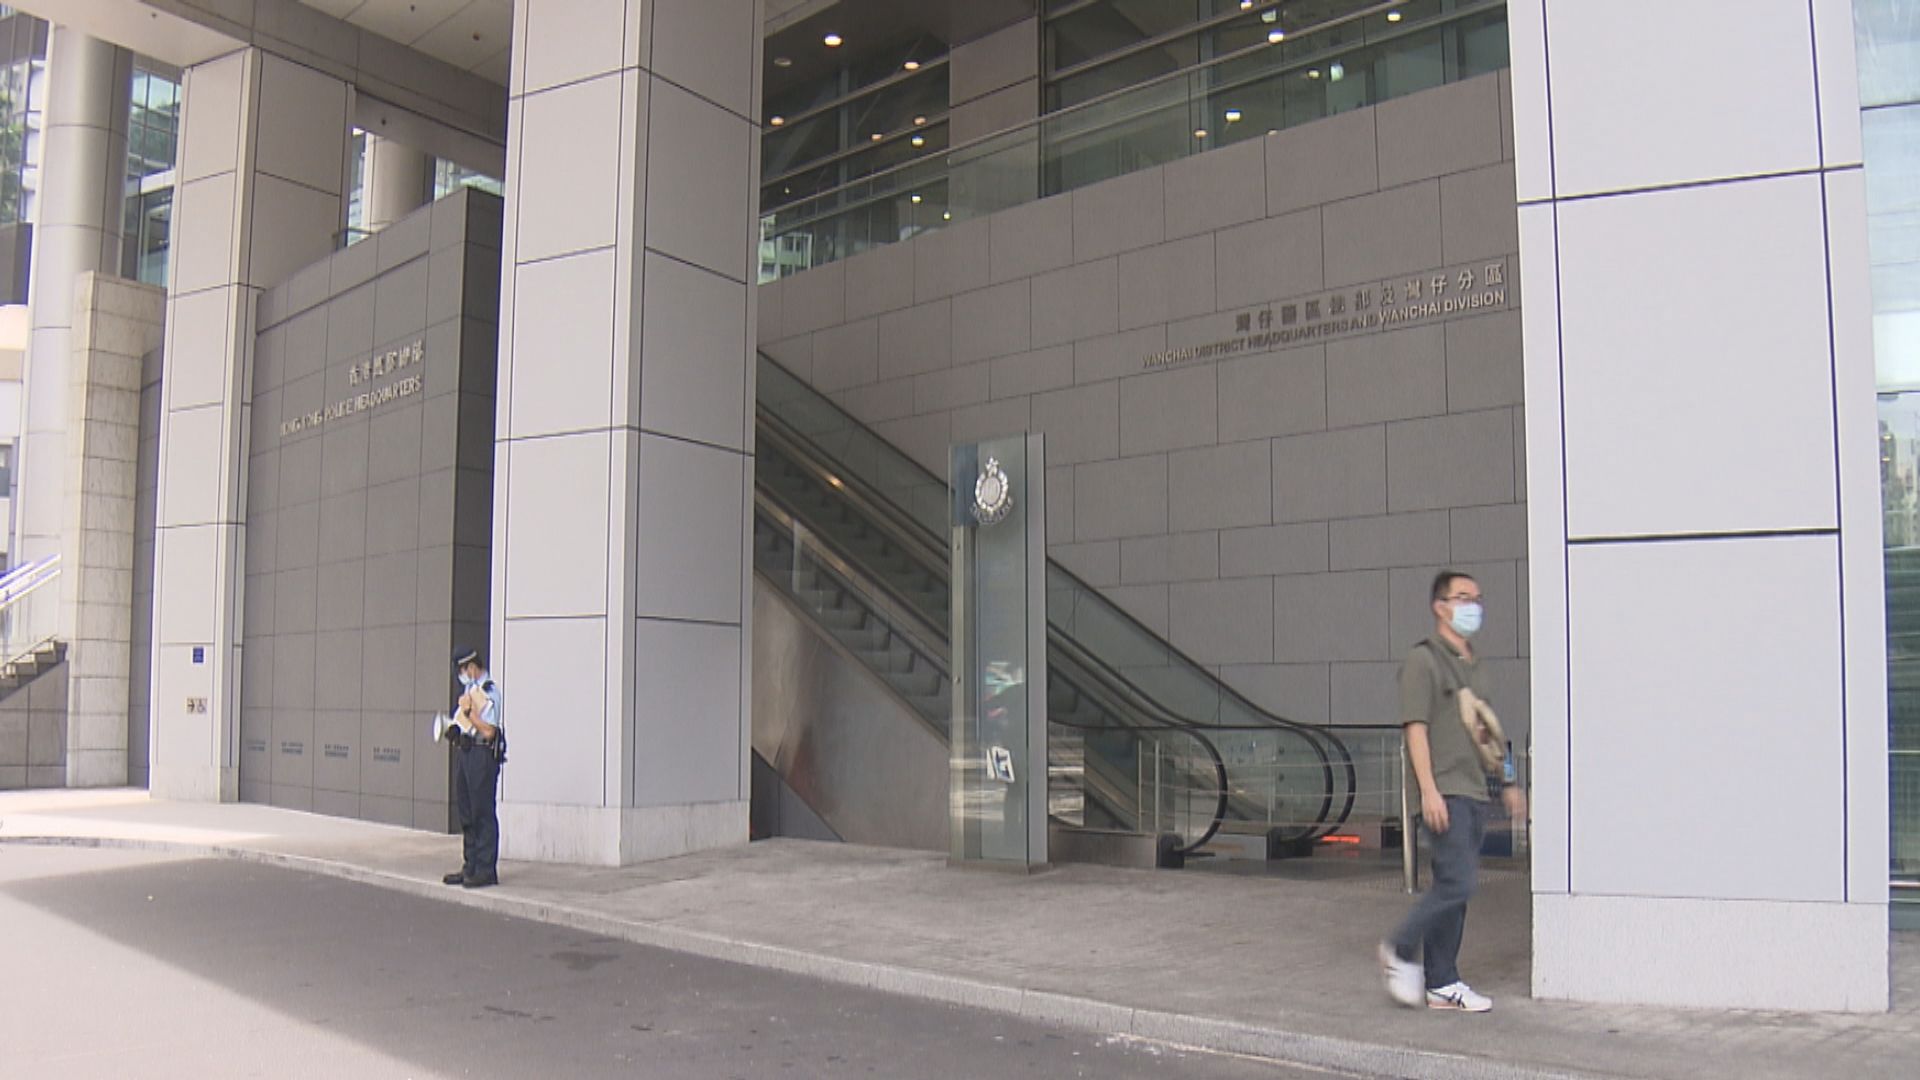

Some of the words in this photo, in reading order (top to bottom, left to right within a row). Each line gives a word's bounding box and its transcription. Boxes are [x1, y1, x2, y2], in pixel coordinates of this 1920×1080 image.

[1142, 346, 1195, 369] WANCHAI
[1196, 337, 1245, 358] DISTRICT
[1248, 317, 1348, 350] HEADQUARTERS
[1350, 312, 1378, 330] AND
[1379, 303, 1441, 325] WANCHAI
[1444, 289, 1505, 313] DIVISION
[354, 374, 421, 413] HEADQUARTERS
